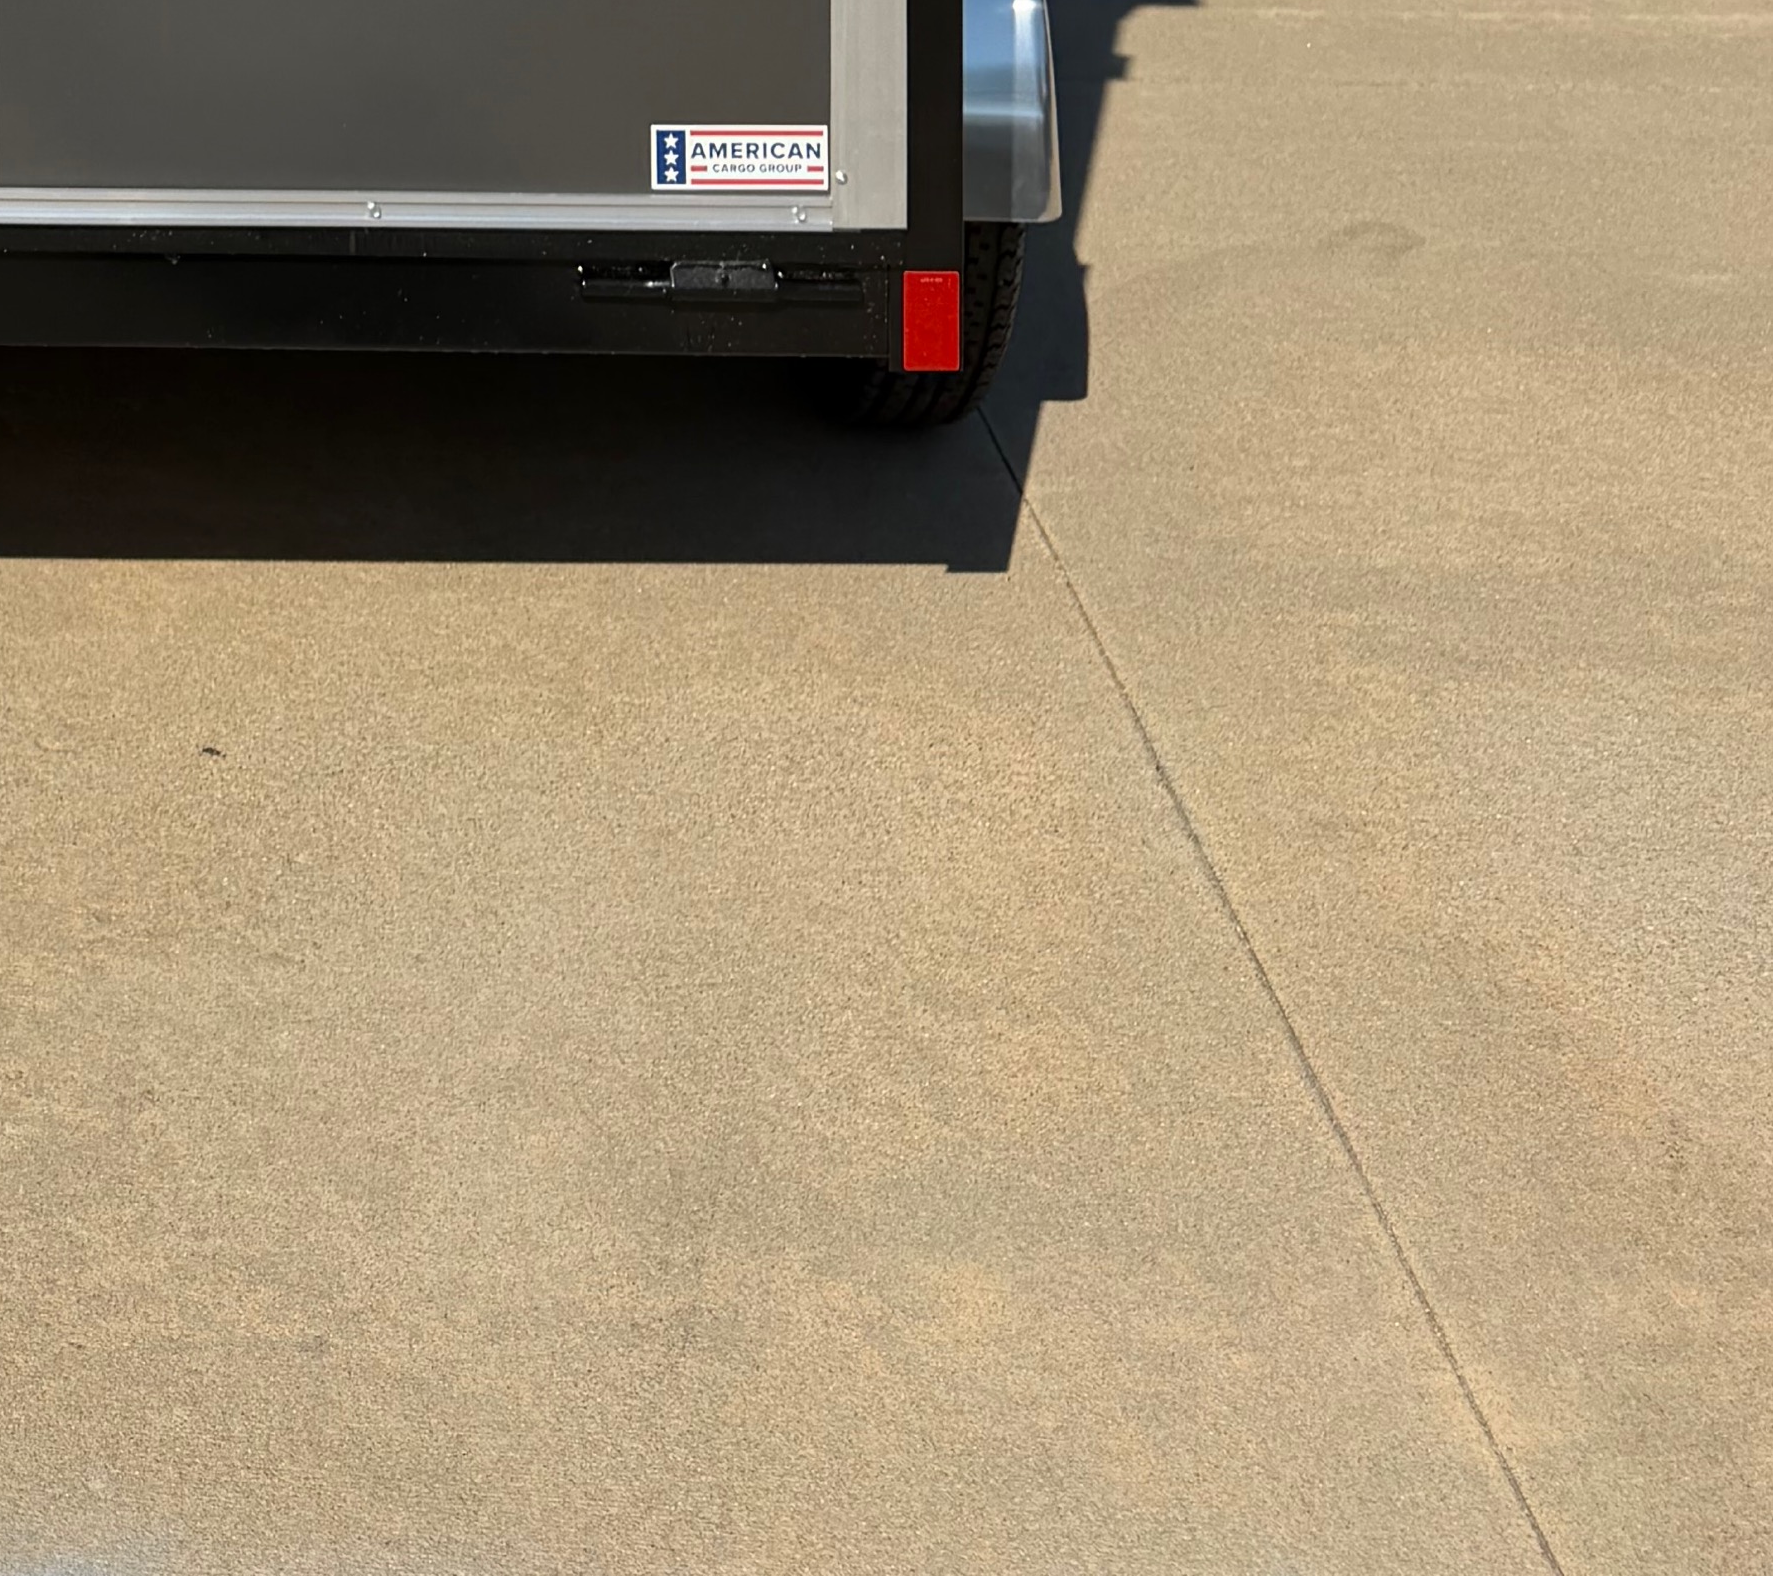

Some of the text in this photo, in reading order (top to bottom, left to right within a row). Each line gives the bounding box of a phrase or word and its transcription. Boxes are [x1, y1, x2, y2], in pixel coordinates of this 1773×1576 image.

[690, 142, 821, 159] AMERICAN
[712, 163, 803, 173] CARGO GROUP
